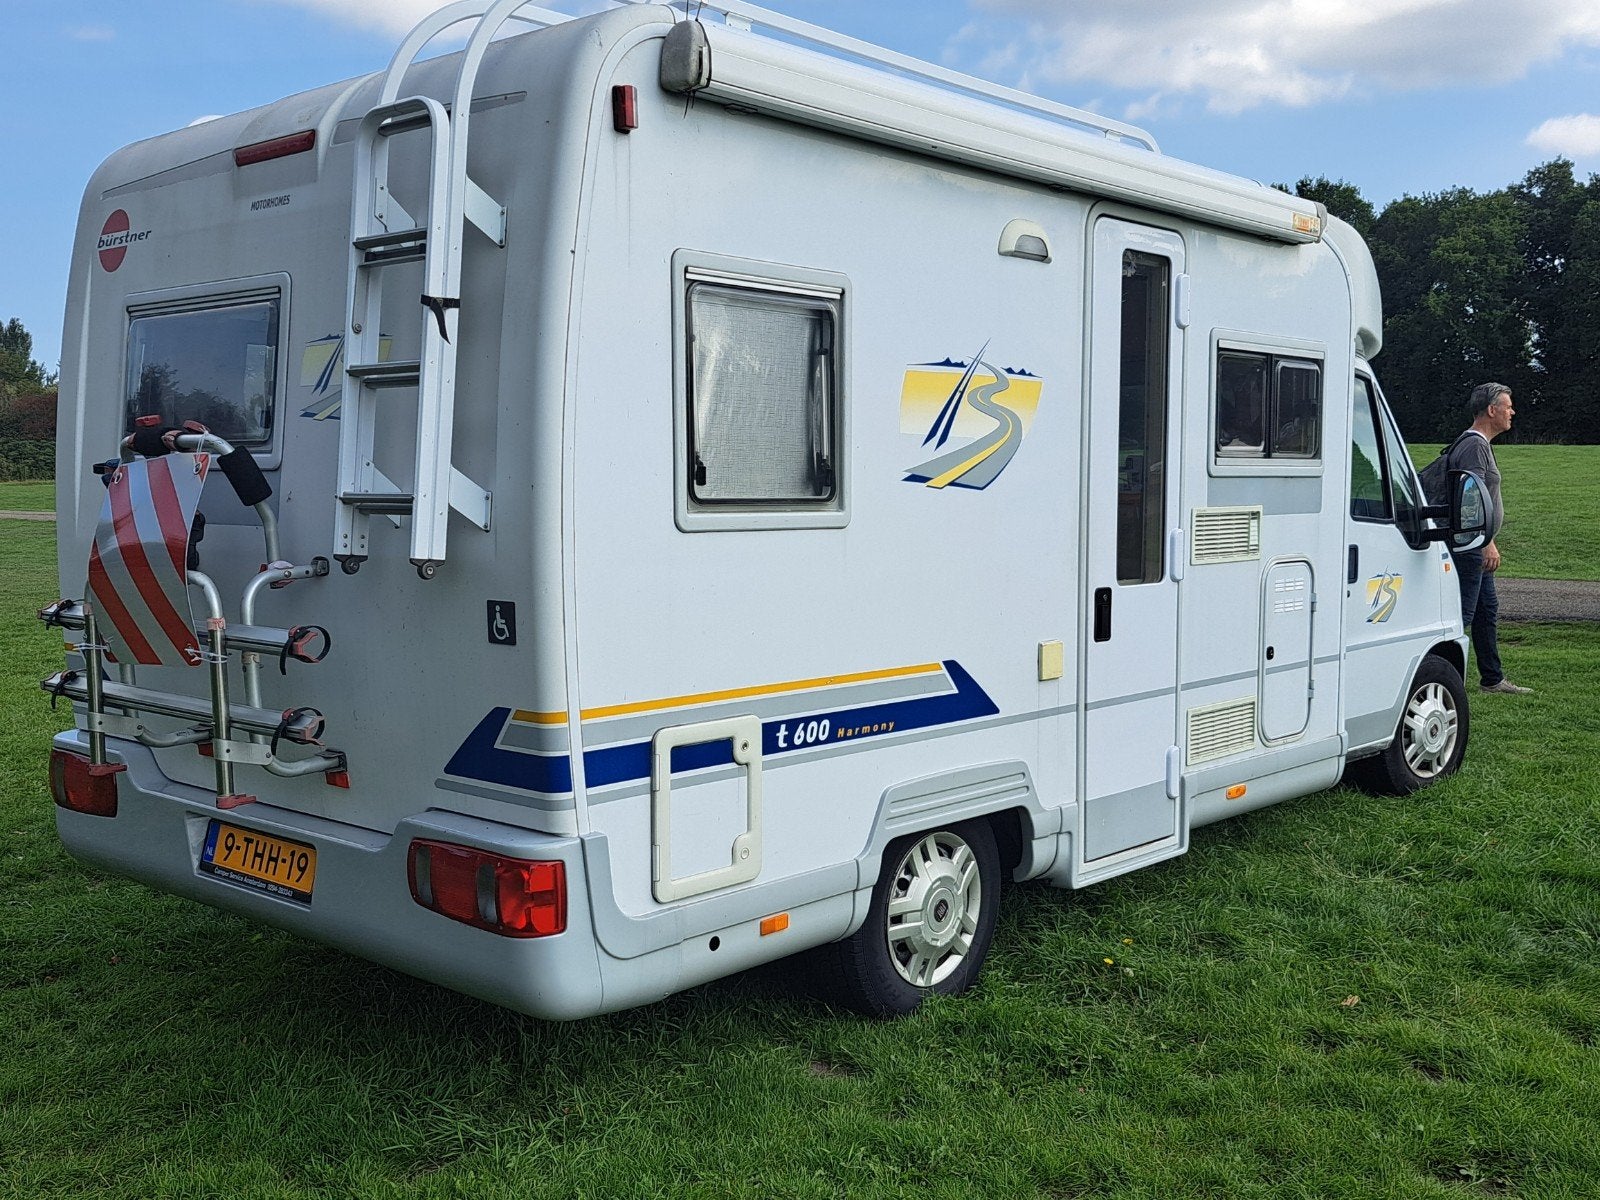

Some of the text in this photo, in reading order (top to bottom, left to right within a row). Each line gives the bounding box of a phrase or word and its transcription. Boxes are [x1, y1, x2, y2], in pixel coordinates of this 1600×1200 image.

[250, 194, 291, 211] MOTORHOMES
[97, 229, 152, 249] bürstner
[776, 719, 895, 748] t 600 Harmony
[205, 846, 214, 856] NL
[223, 832, 309, 883] 9-THH-19
[214, 866, 229, 877] Camper
[229, 871, 243, 881] Service
[244, 875, 267, 889] Amsterdam
